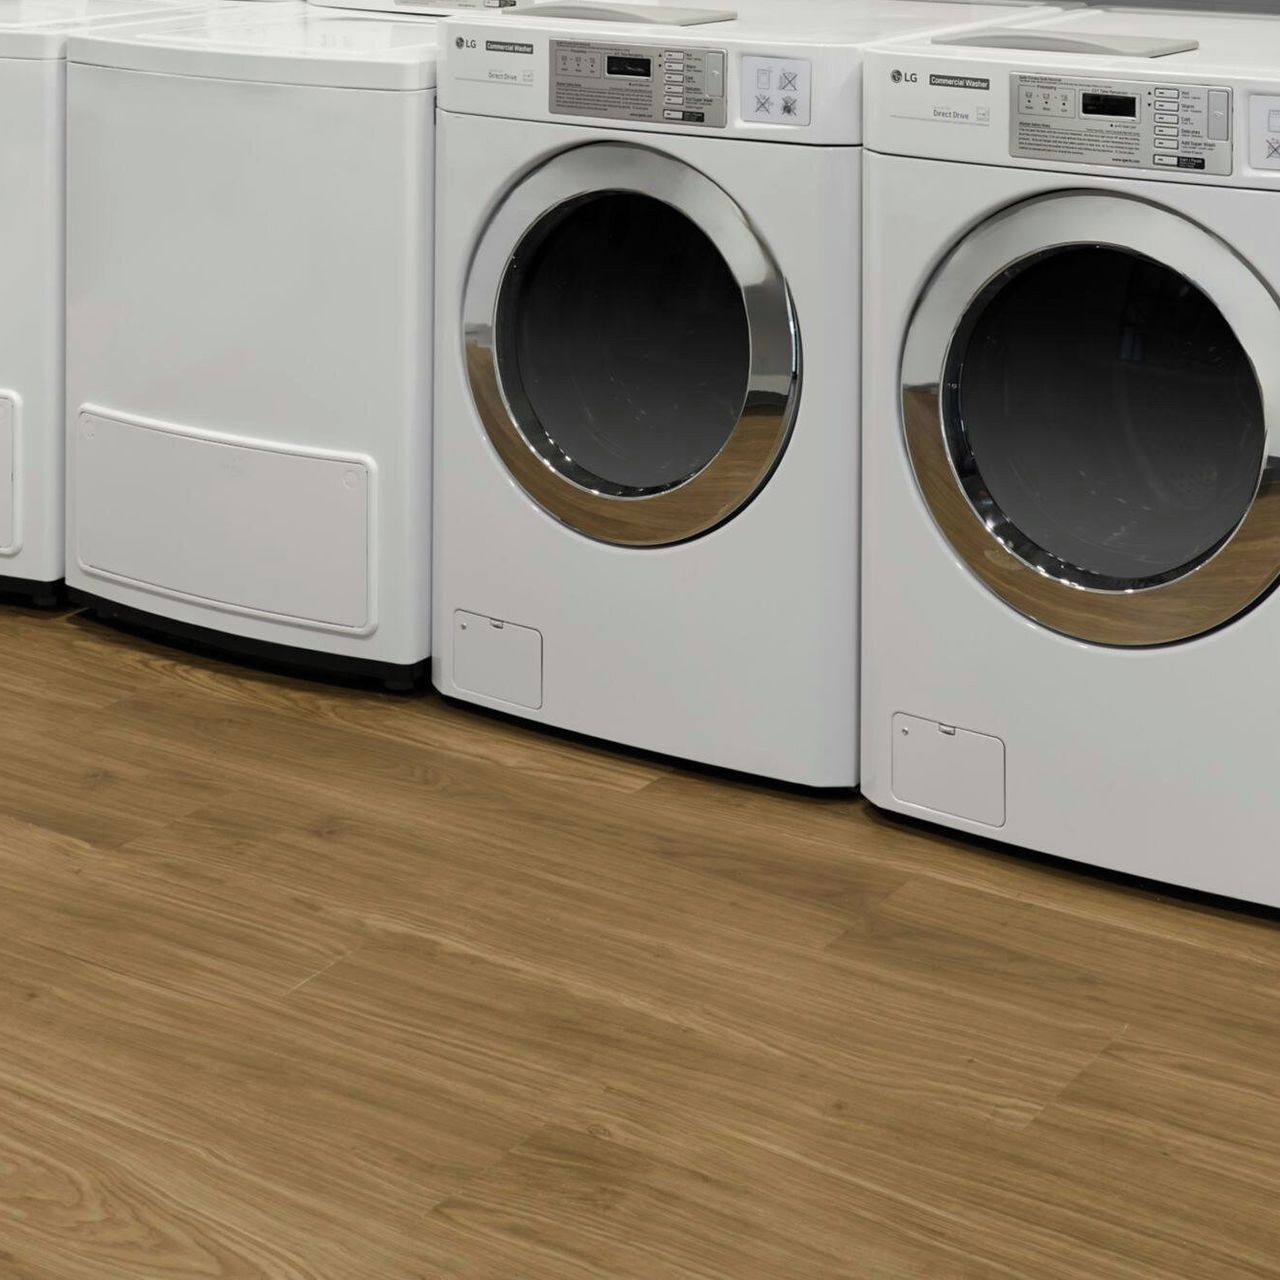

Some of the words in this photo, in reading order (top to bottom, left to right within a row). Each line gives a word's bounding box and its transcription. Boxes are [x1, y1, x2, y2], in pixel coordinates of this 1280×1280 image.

[487, 42, 514, 51] Commercial
[514, 44, 532, 53] Washer
[904, 73, 918, 83] LG
[931, 75, 965, 87] Commercial
[965, 79, 989, 89] Washer
[933, 109, 951, 119] Direct
[952, 111, 969, 121] Drive
